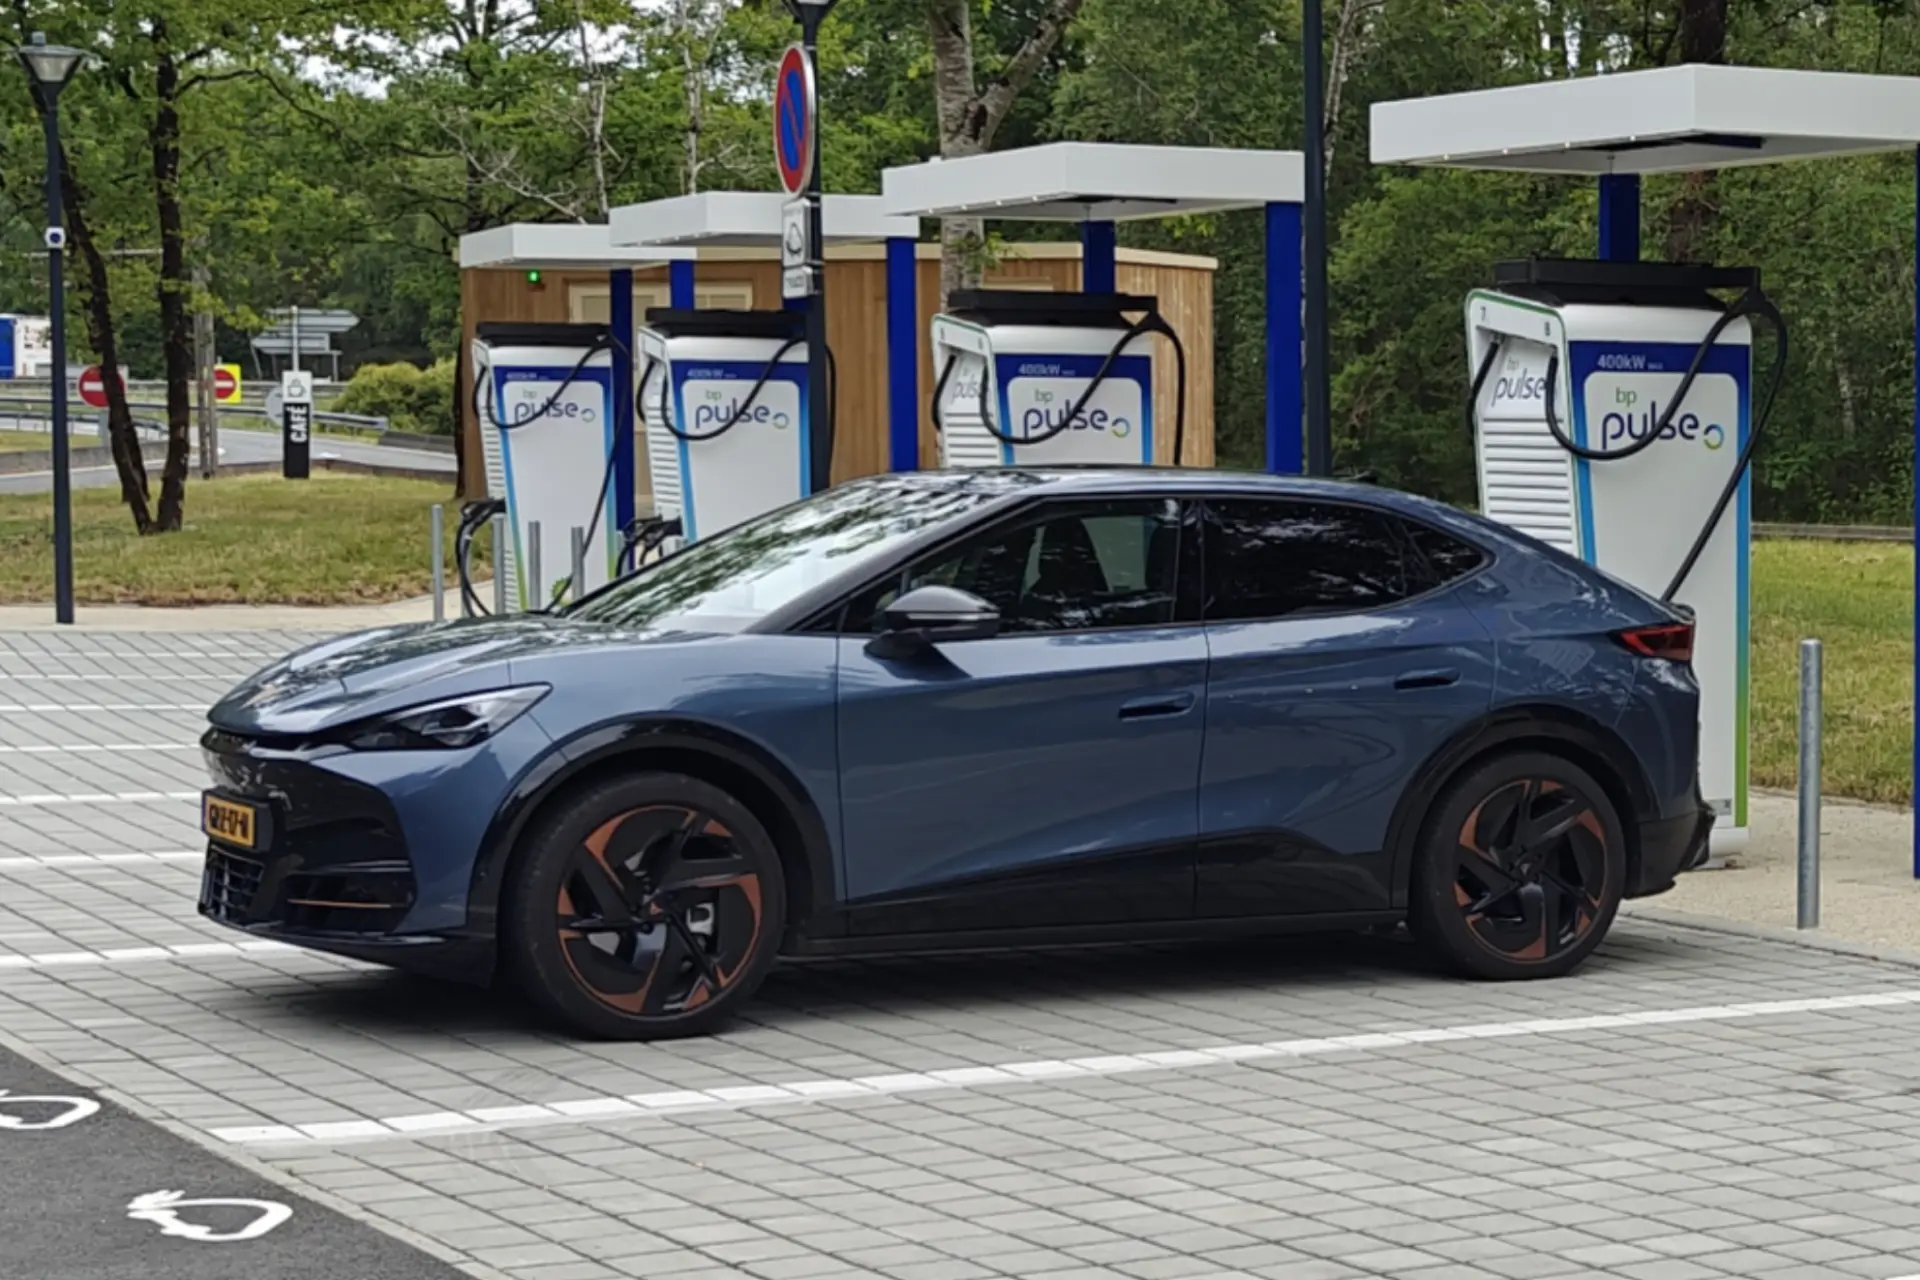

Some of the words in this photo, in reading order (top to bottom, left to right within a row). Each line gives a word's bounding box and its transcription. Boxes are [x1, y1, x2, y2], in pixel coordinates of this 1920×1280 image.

[1597, 354, 1646, 370] 400kW
[1034, 388, 1054, 404] bp
[1615, 386, 1637, 407] bp
[286, 405, 308, 443] CAFÉ
